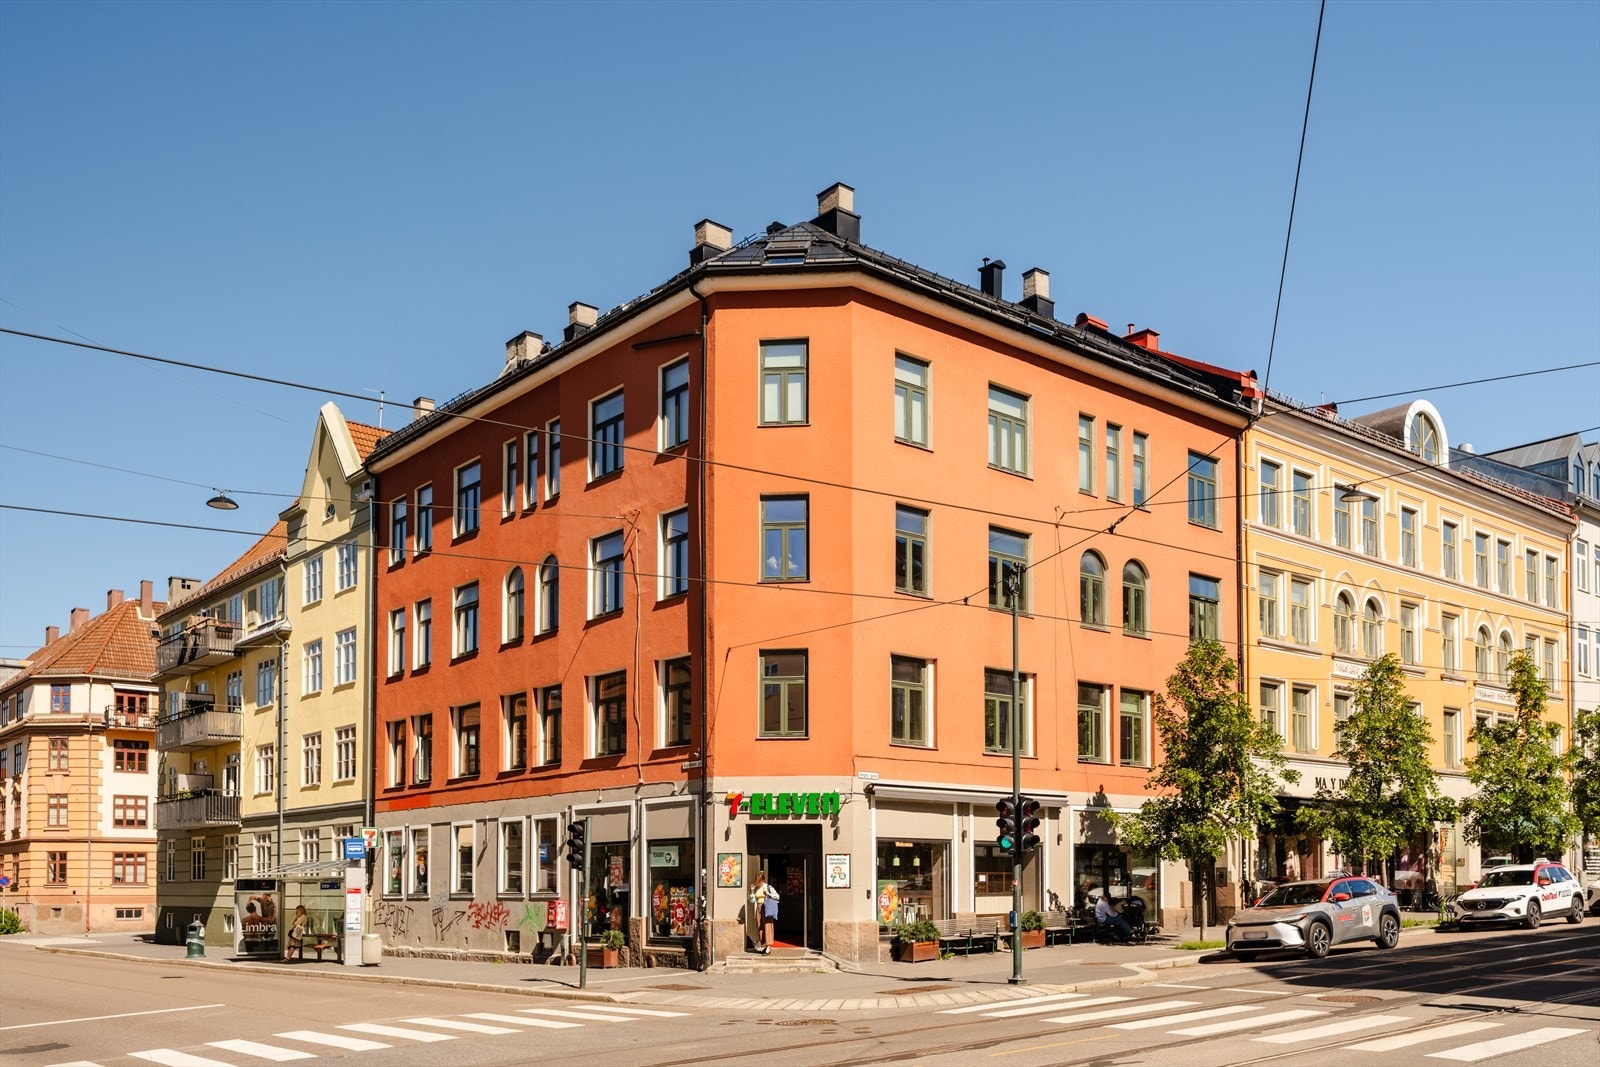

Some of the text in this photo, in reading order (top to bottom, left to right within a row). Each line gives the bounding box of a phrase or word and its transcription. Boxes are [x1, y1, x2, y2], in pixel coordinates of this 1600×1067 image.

[725, 792, 840, 815] 7-ELEVEN
[364, 830, 376, 847] 7
[241, 922, 277, 933] Limbra
